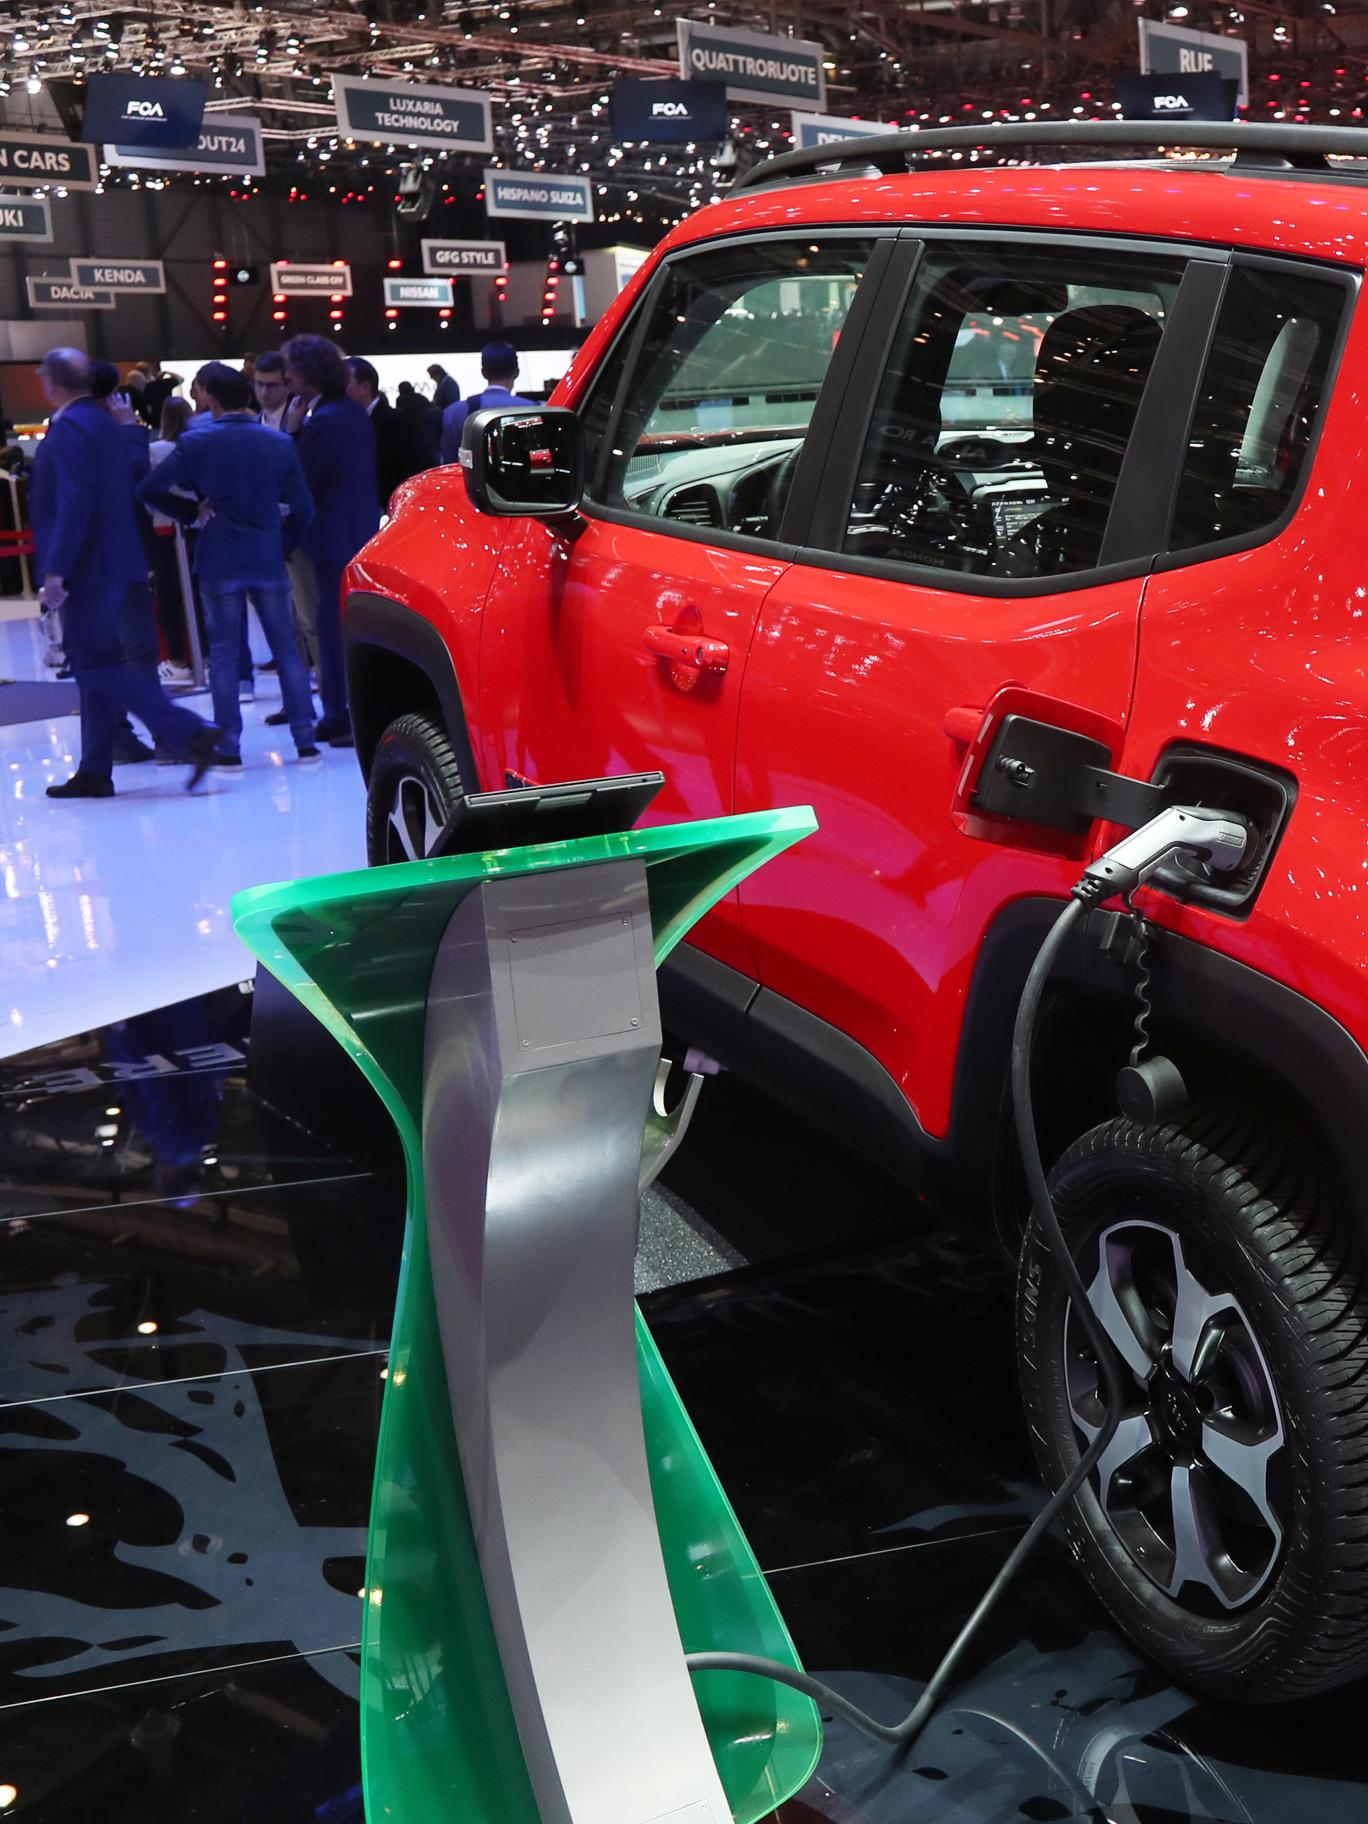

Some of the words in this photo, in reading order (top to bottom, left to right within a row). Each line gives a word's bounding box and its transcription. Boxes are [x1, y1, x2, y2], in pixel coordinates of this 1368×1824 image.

[691, 48, 817, 85] QUATTRORUOTE
[1179, 48, 1213, 73] RUF
[127, 100, 164, 117] FCA
[389, 97, 444, 115] LUXARIA
[652, 102, 688, 116] FCA
[1153, 95, 1189, 109] FCA
[374, 112, 459, 132] TECHNOLOGY
[13, 149, 71, 172] CARS
[497, 186, 549, 203] HISPANO
[550, 190, 584, 206] SUIZA
[435, 250, 460, 264] GFG
[461, 251, 495, 264] STYLE
[94, 268, 146, 284] KENDA
[51, 286, 95, 300] DACIA
[399, 286, 440, 299] NISSAN
